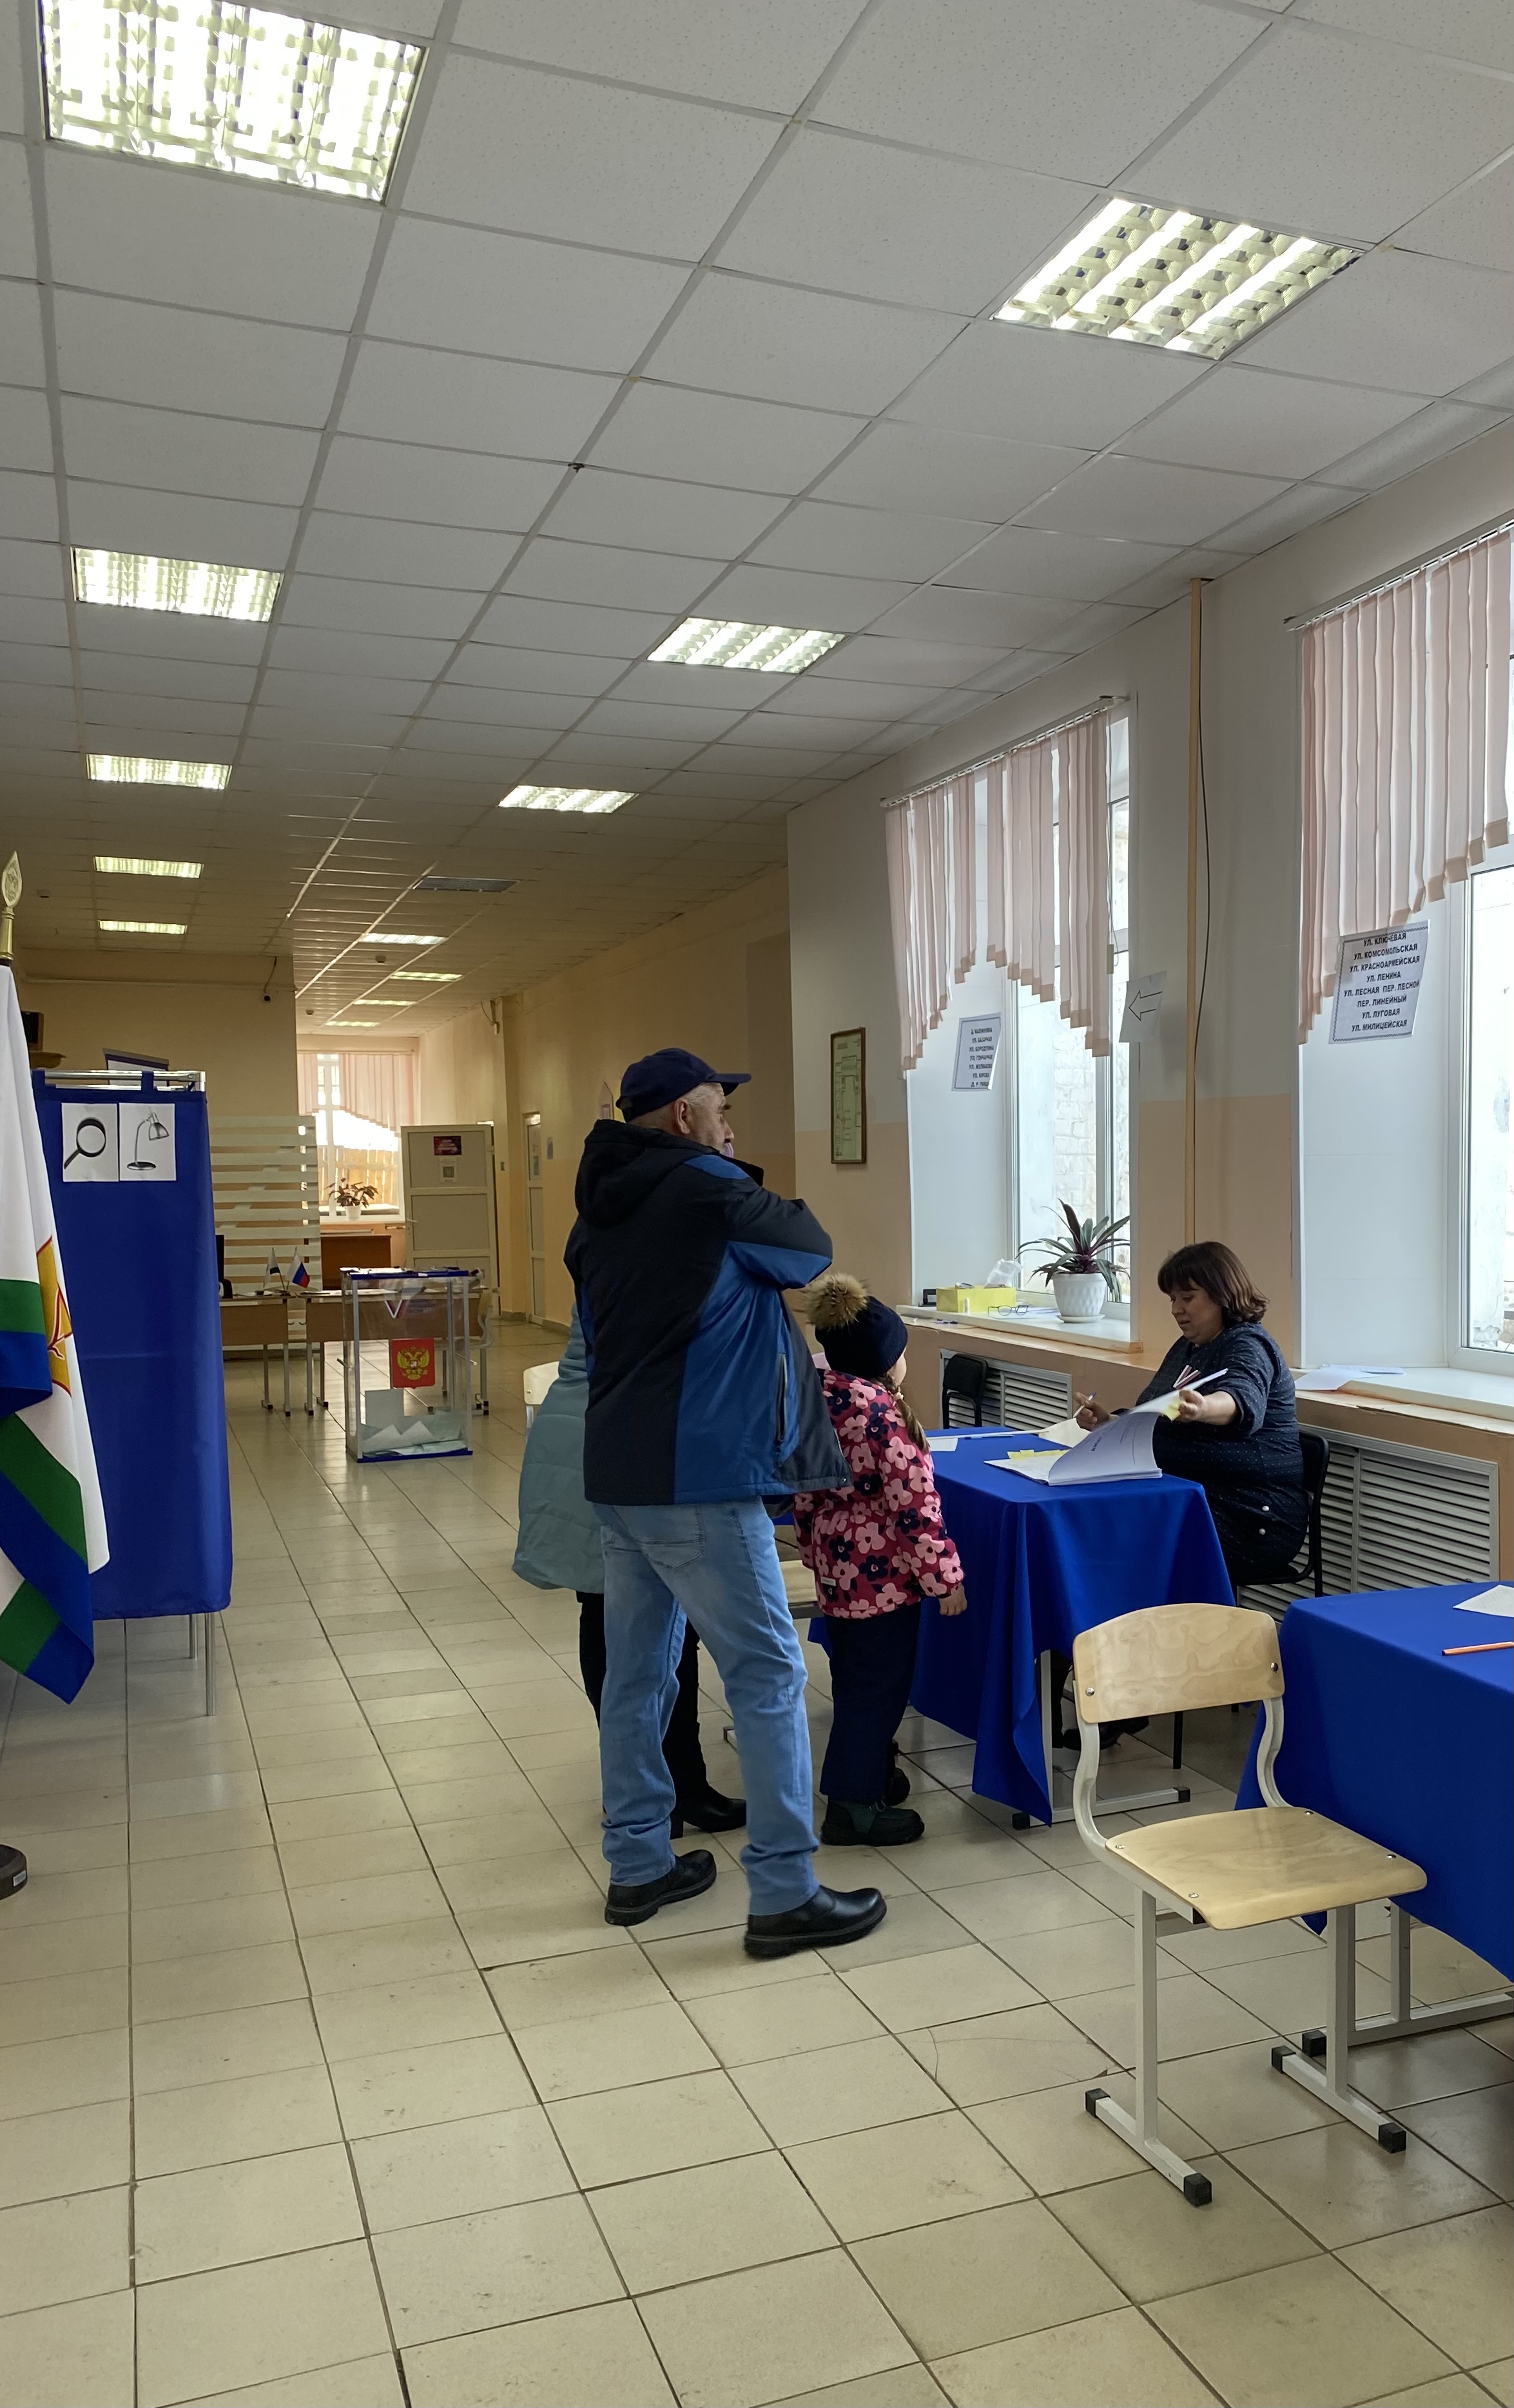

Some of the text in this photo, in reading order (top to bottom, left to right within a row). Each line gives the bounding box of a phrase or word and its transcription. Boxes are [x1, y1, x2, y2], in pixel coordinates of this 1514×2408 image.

[1363, 933, 1406, 947] УЛ. КЛЮЧЕВАЯ
[1364, 943, 1417, 958] КОМСОМОЛЬСКАЯ
[1361, 956, 1420, 970] КРАСНОАРМЕЙСКАЯ
[1377, 970, 1401, 980] ЛЕНИНА
[1354, 986, 1379, 996] ЛЕСНАЯ
[1383, 984, 1397, 992] ПЕР.
[1357, 994, 1407, 1008] ПЕР. ЛИНЕЙНЫЙ
[1361, 1008, 1401, 1019] УЛ. ЛУГОВАЯ
[1352, 1019, 1408, 1032] УЛ. МИЛИЦЕЙСКАЯ
